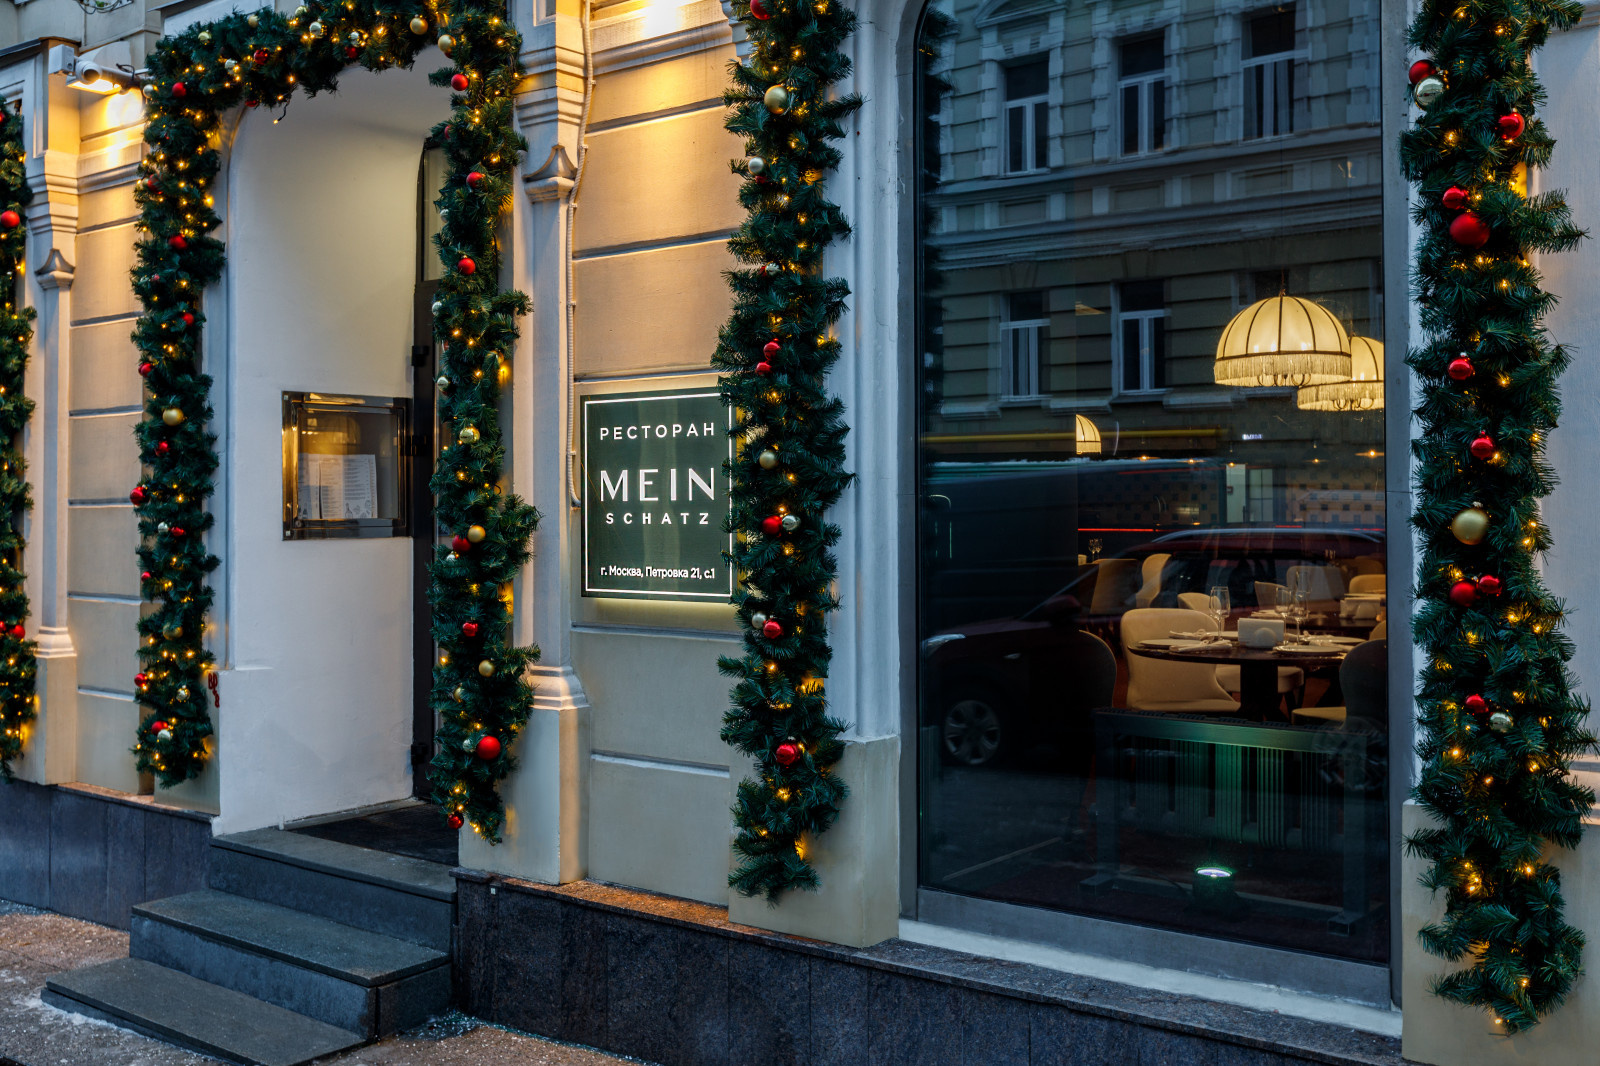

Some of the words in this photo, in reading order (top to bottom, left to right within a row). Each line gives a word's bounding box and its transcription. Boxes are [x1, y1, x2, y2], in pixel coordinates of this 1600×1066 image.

[600, 422, 714, 440] РЕСТОРАН
[601, 468, 714, 501] MEIN
[606, 512, 709, 525] SCHATZ
[609, 566, 643, 578] Москва,
[646, 566, 688, 579] Петровка
[691, 568, 702, 579] 21,
